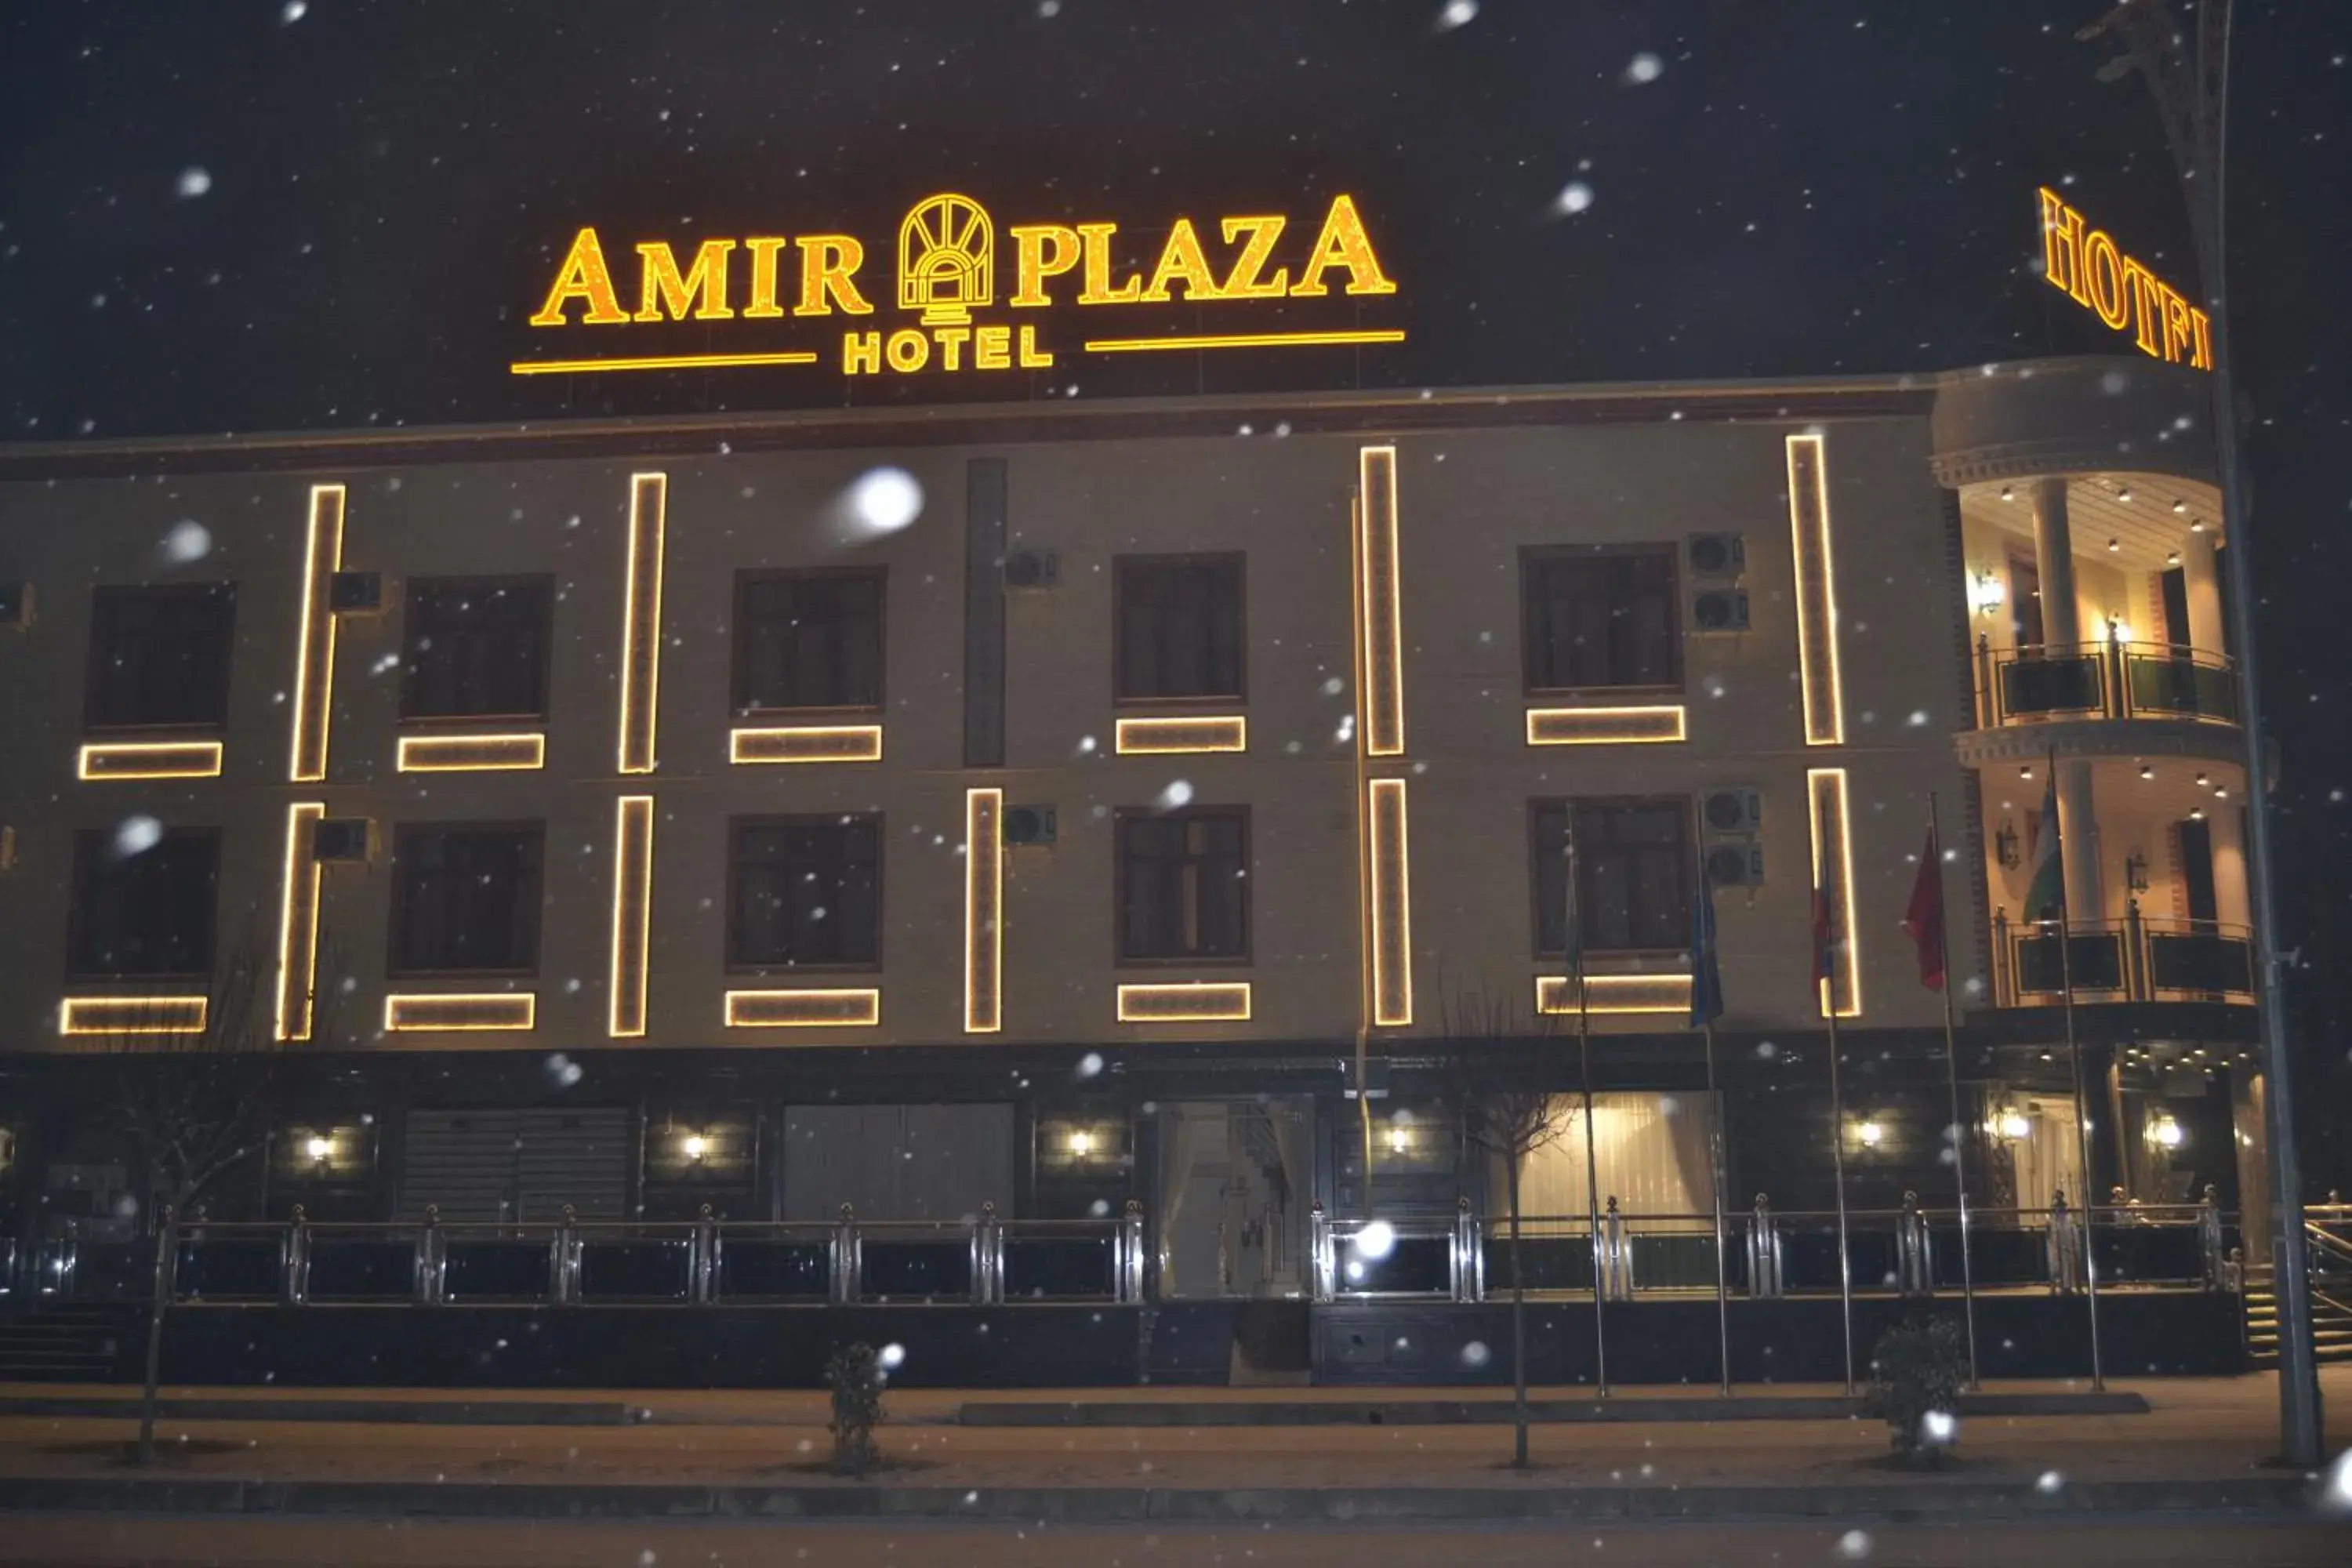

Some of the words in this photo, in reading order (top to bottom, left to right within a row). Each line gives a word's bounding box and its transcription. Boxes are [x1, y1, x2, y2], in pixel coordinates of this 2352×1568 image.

[529, 227, 875, 327] AMIR
[1008, 194, 1397, 308] PLAZA
[843, 325, 1054, 376] HOTEL
